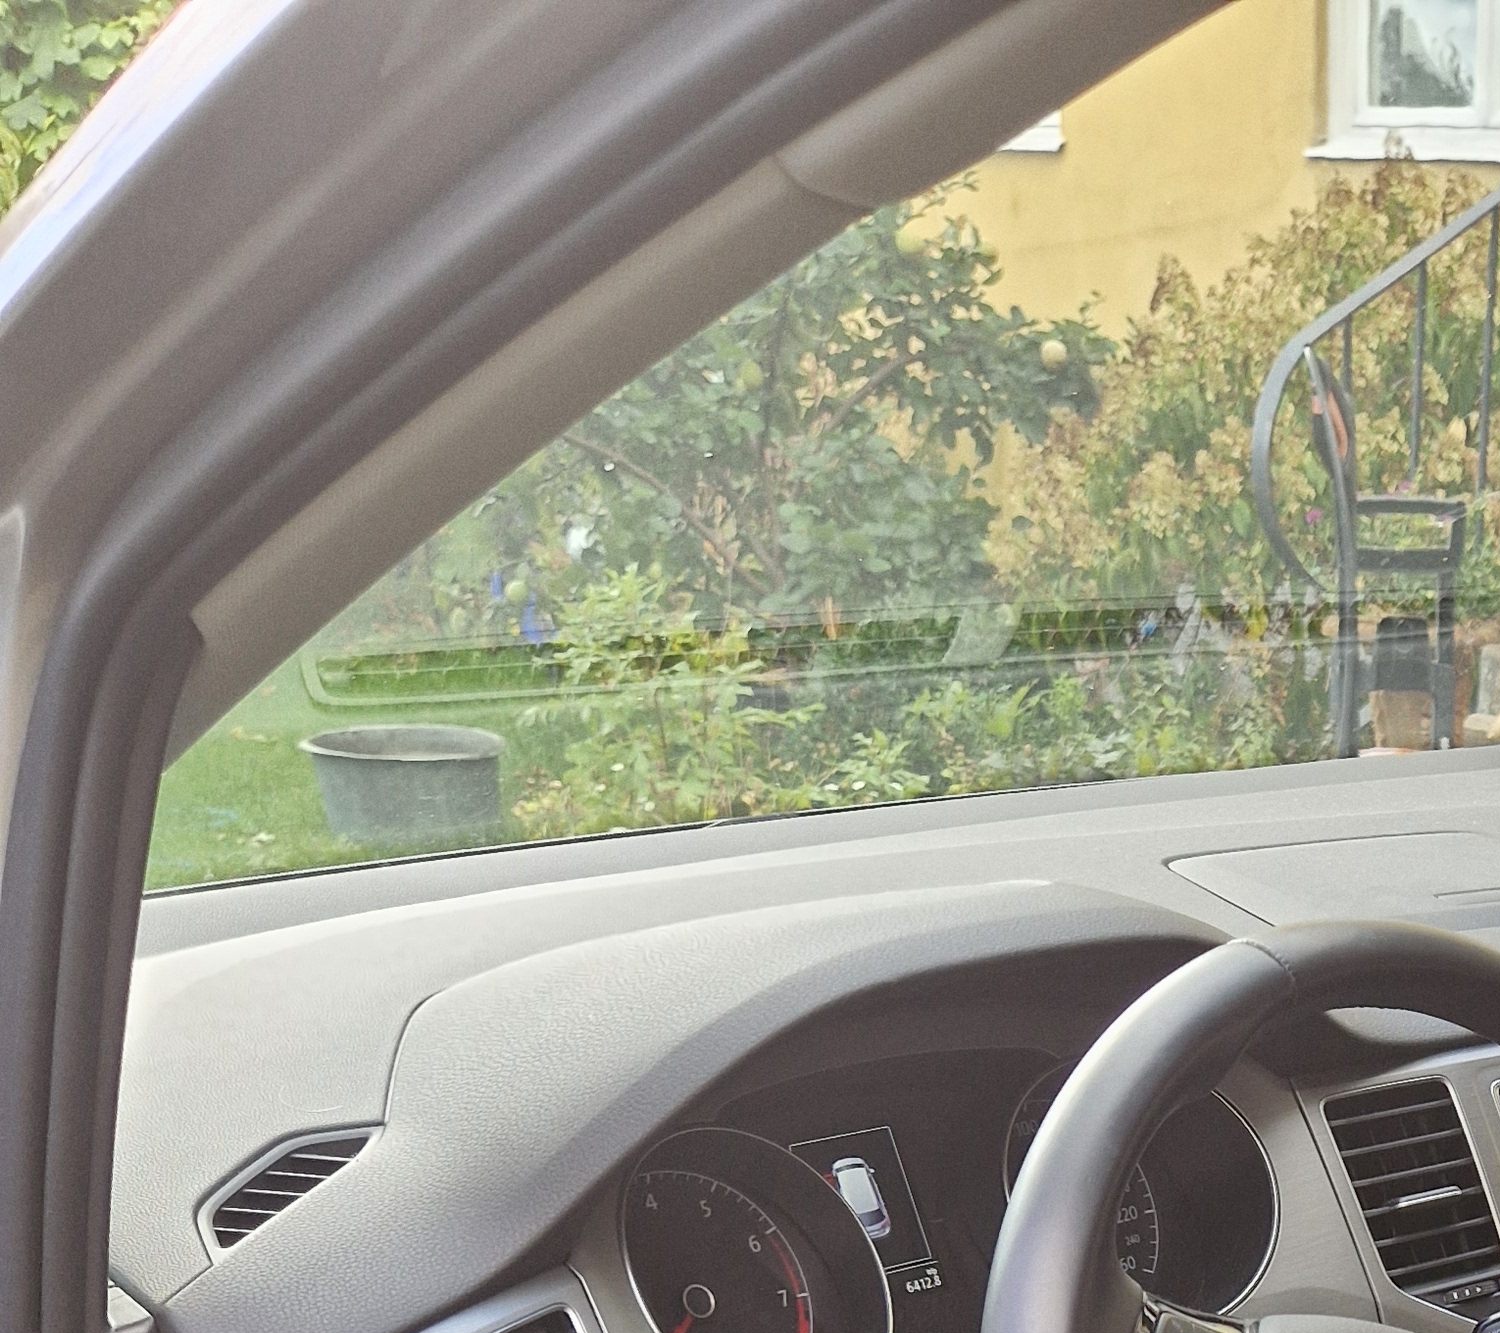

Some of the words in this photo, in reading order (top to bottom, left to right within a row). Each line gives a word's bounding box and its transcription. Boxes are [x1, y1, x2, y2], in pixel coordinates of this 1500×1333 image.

[645, 1193, 658, 1210] 4
[699, 1199, 712, 1218] 5
[748, 1235, 761, 1252] 6
[906, 1274, 942, 1293] 6412.8
[777, 1289, 789, 1307] 7
